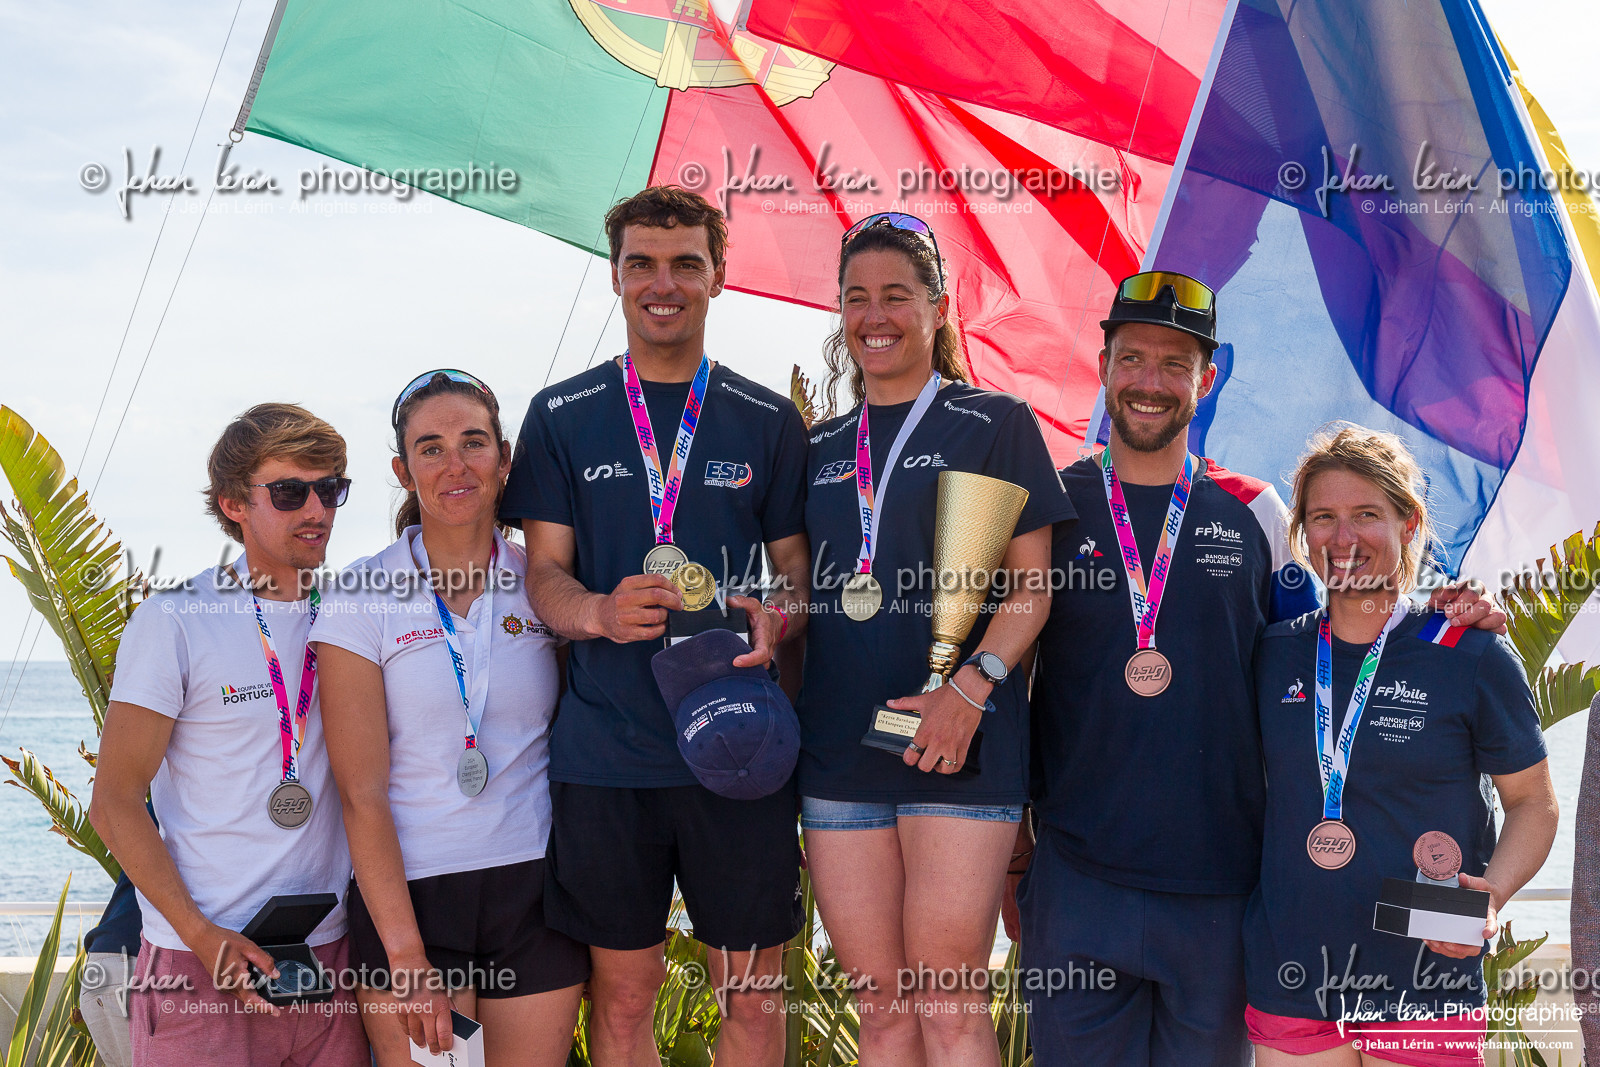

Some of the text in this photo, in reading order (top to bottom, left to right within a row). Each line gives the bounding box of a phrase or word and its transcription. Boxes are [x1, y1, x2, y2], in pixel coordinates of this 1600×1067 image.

[563, 383, 607, 403] Iberdrola
[824, 415, 858, 438] Iberdrola
[705, 460, 749, 482] ESP
[815, 460, 857, 481] ESP
[396, 628, 444, 644] FIDELIDAD
[1130, 665, 1166, 681] 470
[223, 688, 274, 706] PORTUGA
[1370, 720, 1408, 730] POPULAIRE
[1380, 716, 1408, 724] BANQUE
[272, 797, 309, 814] 470
[1311, 836, 1351, 853] 470
